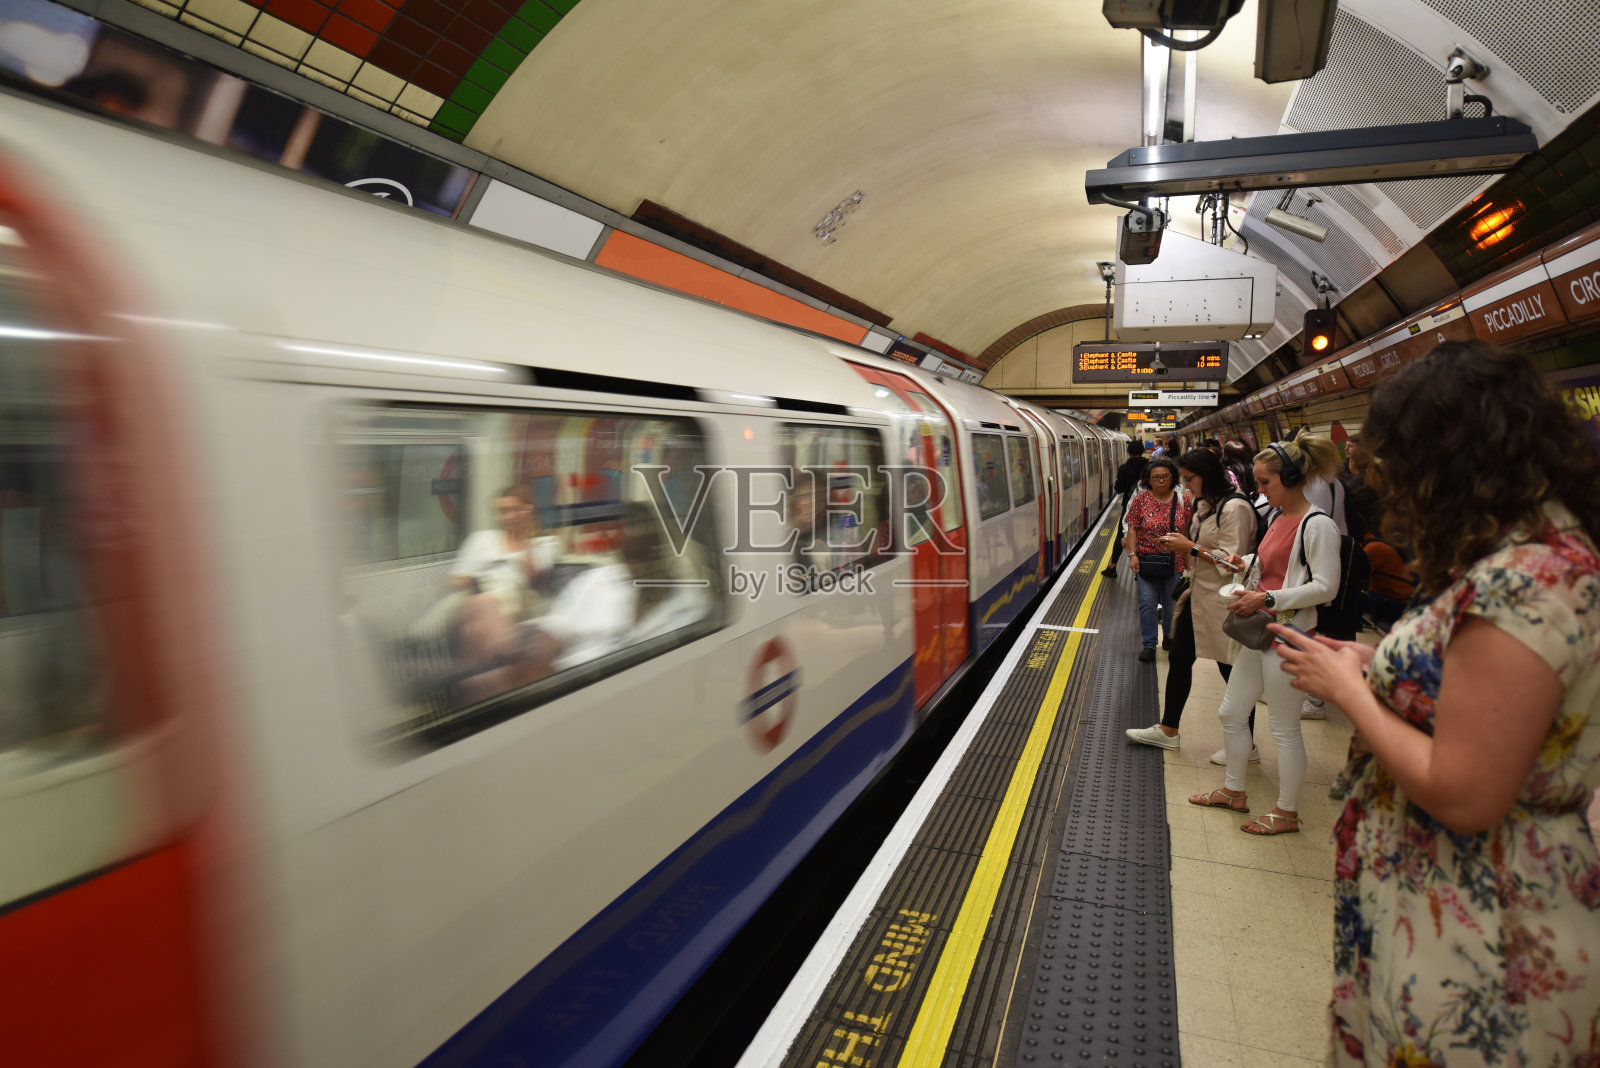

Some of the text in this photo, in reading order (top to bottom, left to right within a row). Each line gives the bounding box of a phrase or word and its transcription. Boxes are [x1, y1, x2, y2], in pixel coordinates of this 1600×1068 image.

[1484, 294, 1545, 333] PICCADILLY
[815, 909, 938, 1068] MIND TH
